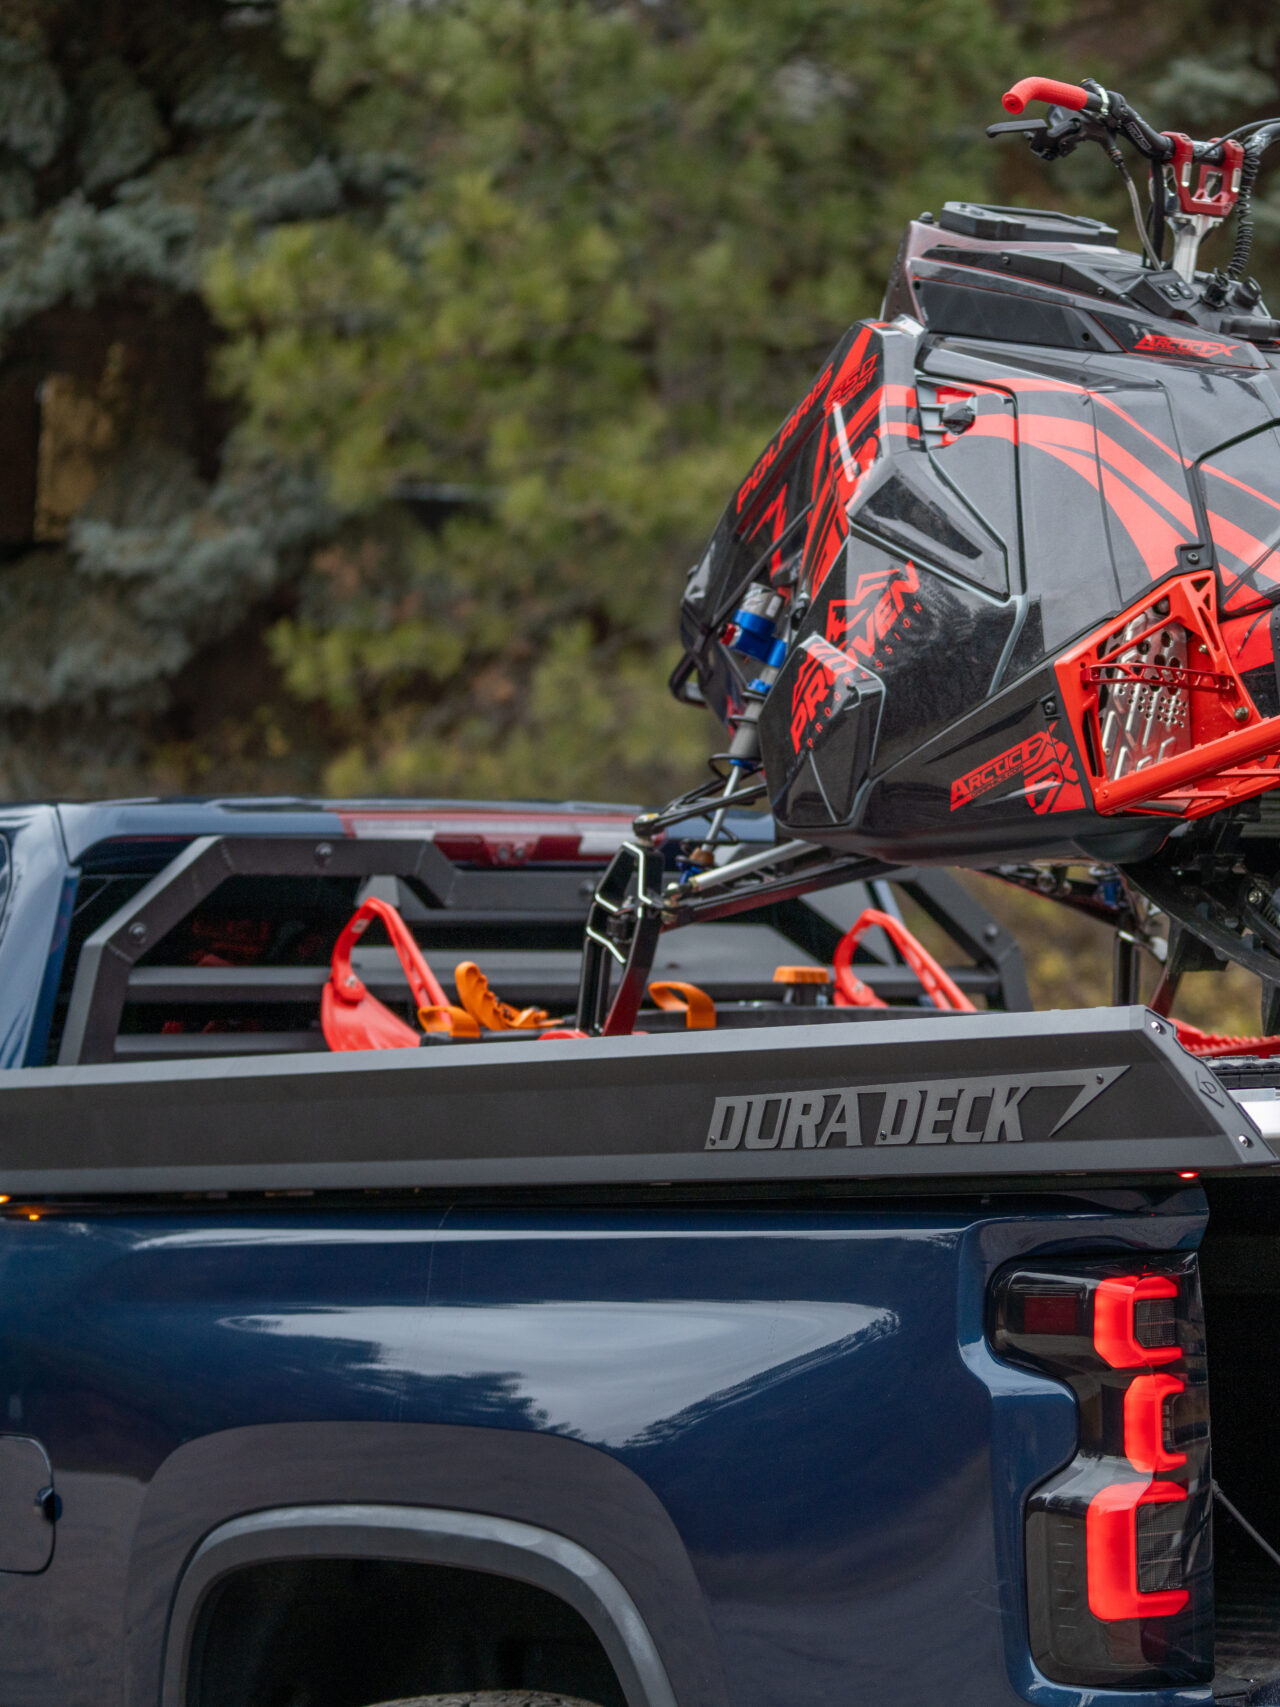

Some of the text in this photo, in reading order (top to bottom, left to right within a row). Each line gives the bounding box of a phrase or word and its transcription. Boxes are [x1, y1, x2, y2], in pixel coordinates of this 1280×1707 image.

[736, 361, 834, 515] POLARIS
[790, 559, 921, 756] PROVEN
[806, 601, 924, 749] PROGRESSION
[704, 1086, 1032, 1150] DURA DECK
